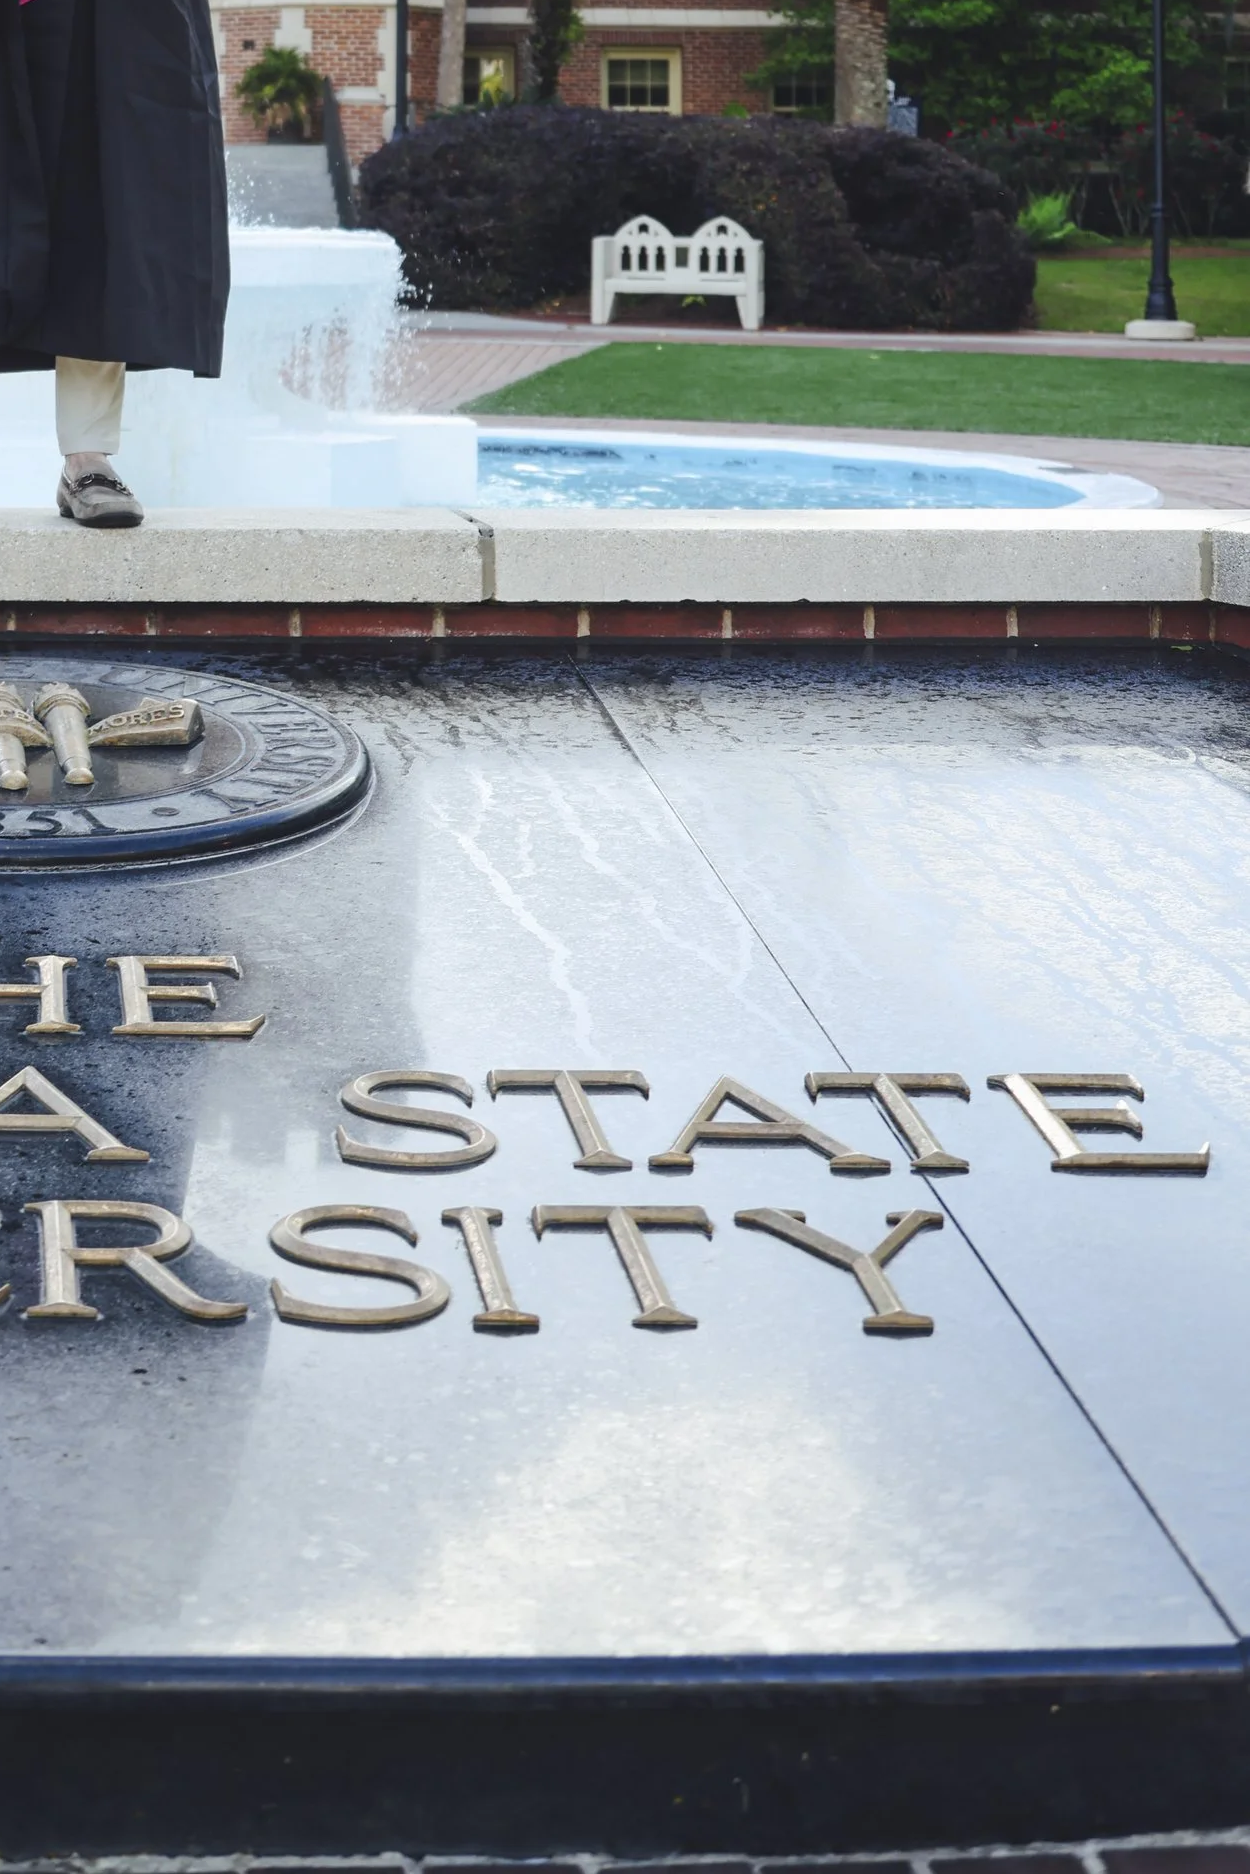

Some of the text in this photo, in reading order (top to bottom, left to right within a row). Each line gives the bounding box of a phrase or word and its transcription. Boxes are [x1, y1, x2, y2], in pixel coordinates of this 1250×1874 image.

[88, 704, 185, 736] MORES
[99, 666, 337, 814] UNIVERSITY
[335, 1069, 1212, 1175] STATE
